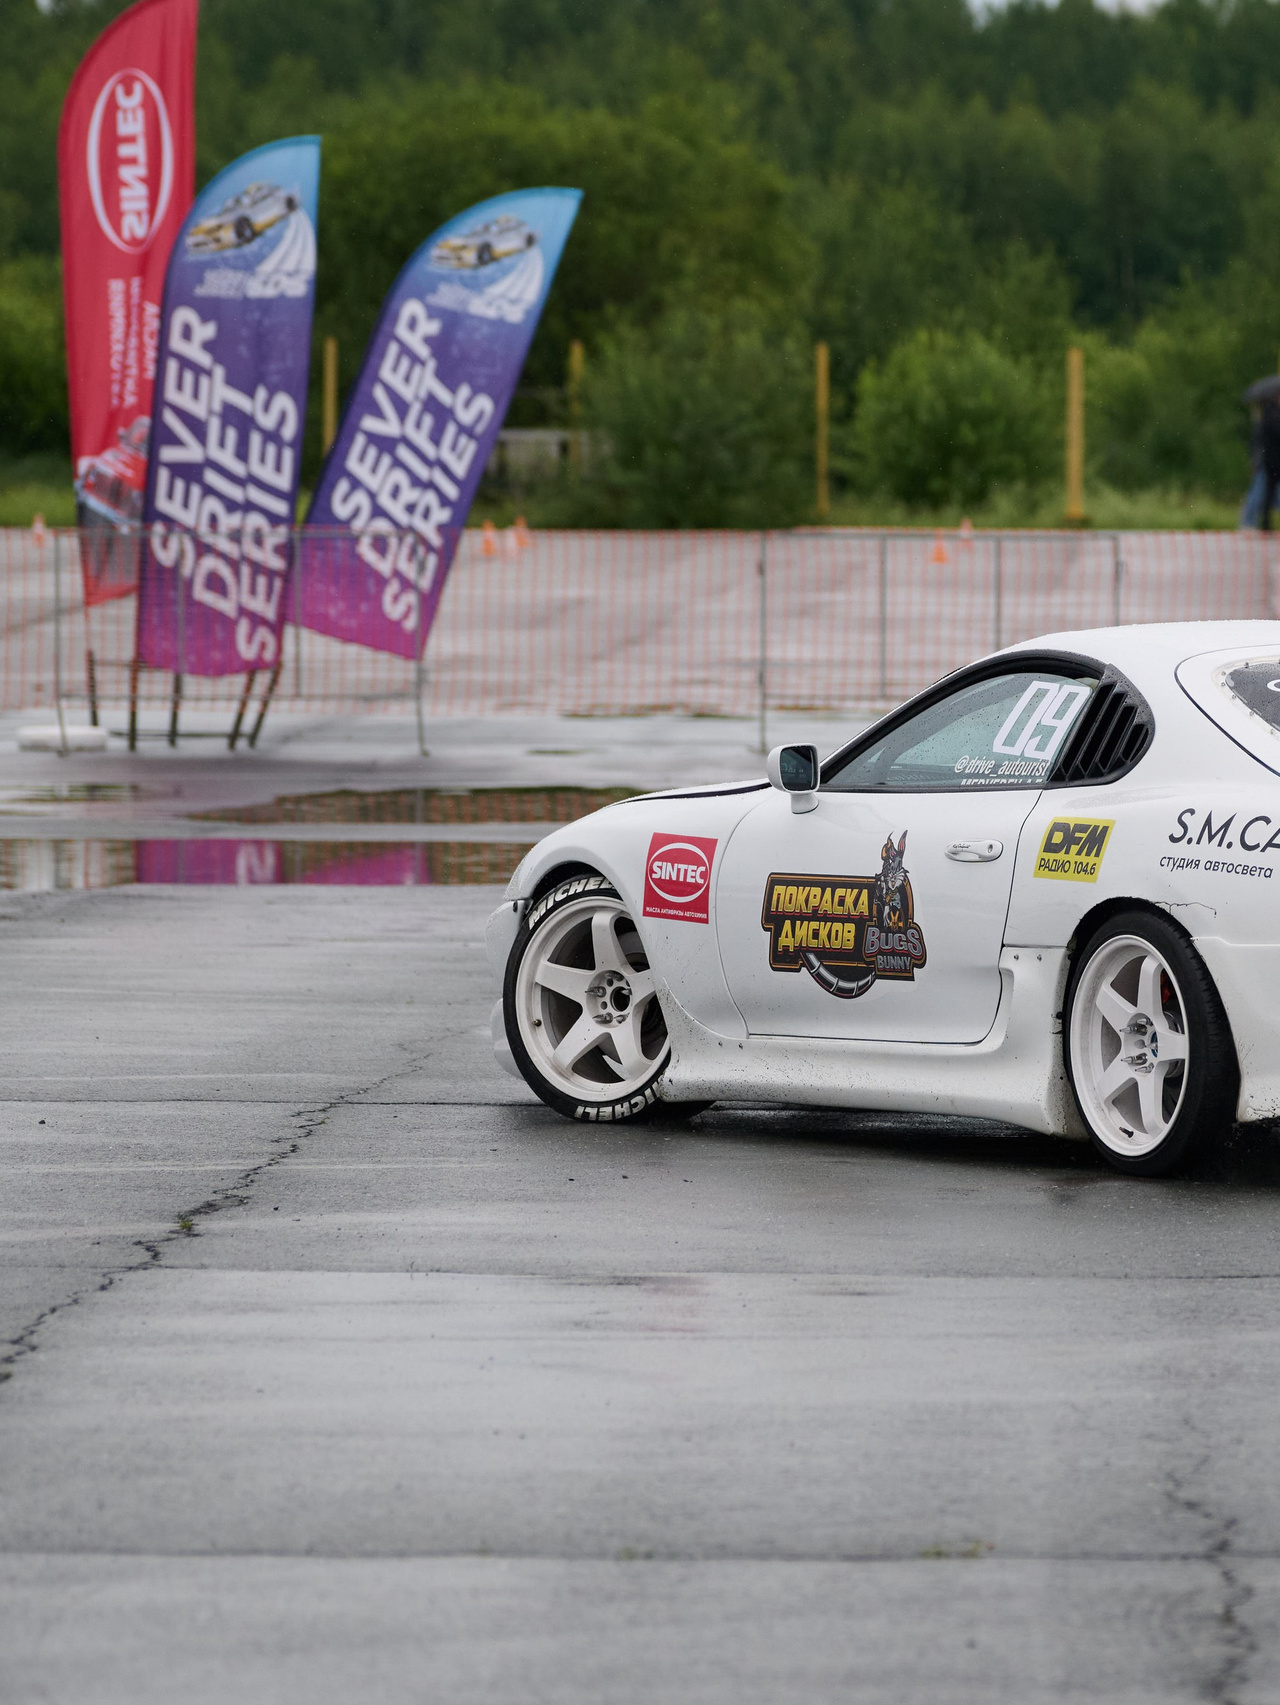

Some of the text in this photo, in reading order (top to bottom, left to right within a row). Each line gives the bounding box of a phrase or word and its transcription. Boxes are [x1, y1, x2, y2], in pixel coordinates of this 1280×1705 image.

[331, 298, 444, 542] SEVER
[151, 305, 217, 578] SEVER
[355, 360, 456, 580] DRIFT
[190, 363, 254, 621] DRIFT
[381, 382, 496, 631] SERIES
[235, 385, 299, 664] SERIES
[993, 681, 1090, 759] 09
[954, 755, 1051, 777] @drive_autourist
[1042, 822, 1110, 858] DFM
[651, 860, 706, 885] SINTEC
[1038, 857, 1097, 876] РАДИО 104.6
[1159, 856, 1274, 878] студия автосвета
[528, 876, 616, 931] MICHEL
[770, 885, 870, 918] ПОКРАСКА
[777, 919, 857, 954] ДИСКОВ
[865, 926, 923, 957] BUGS
[876, 955, 912, 970] BUNNY
